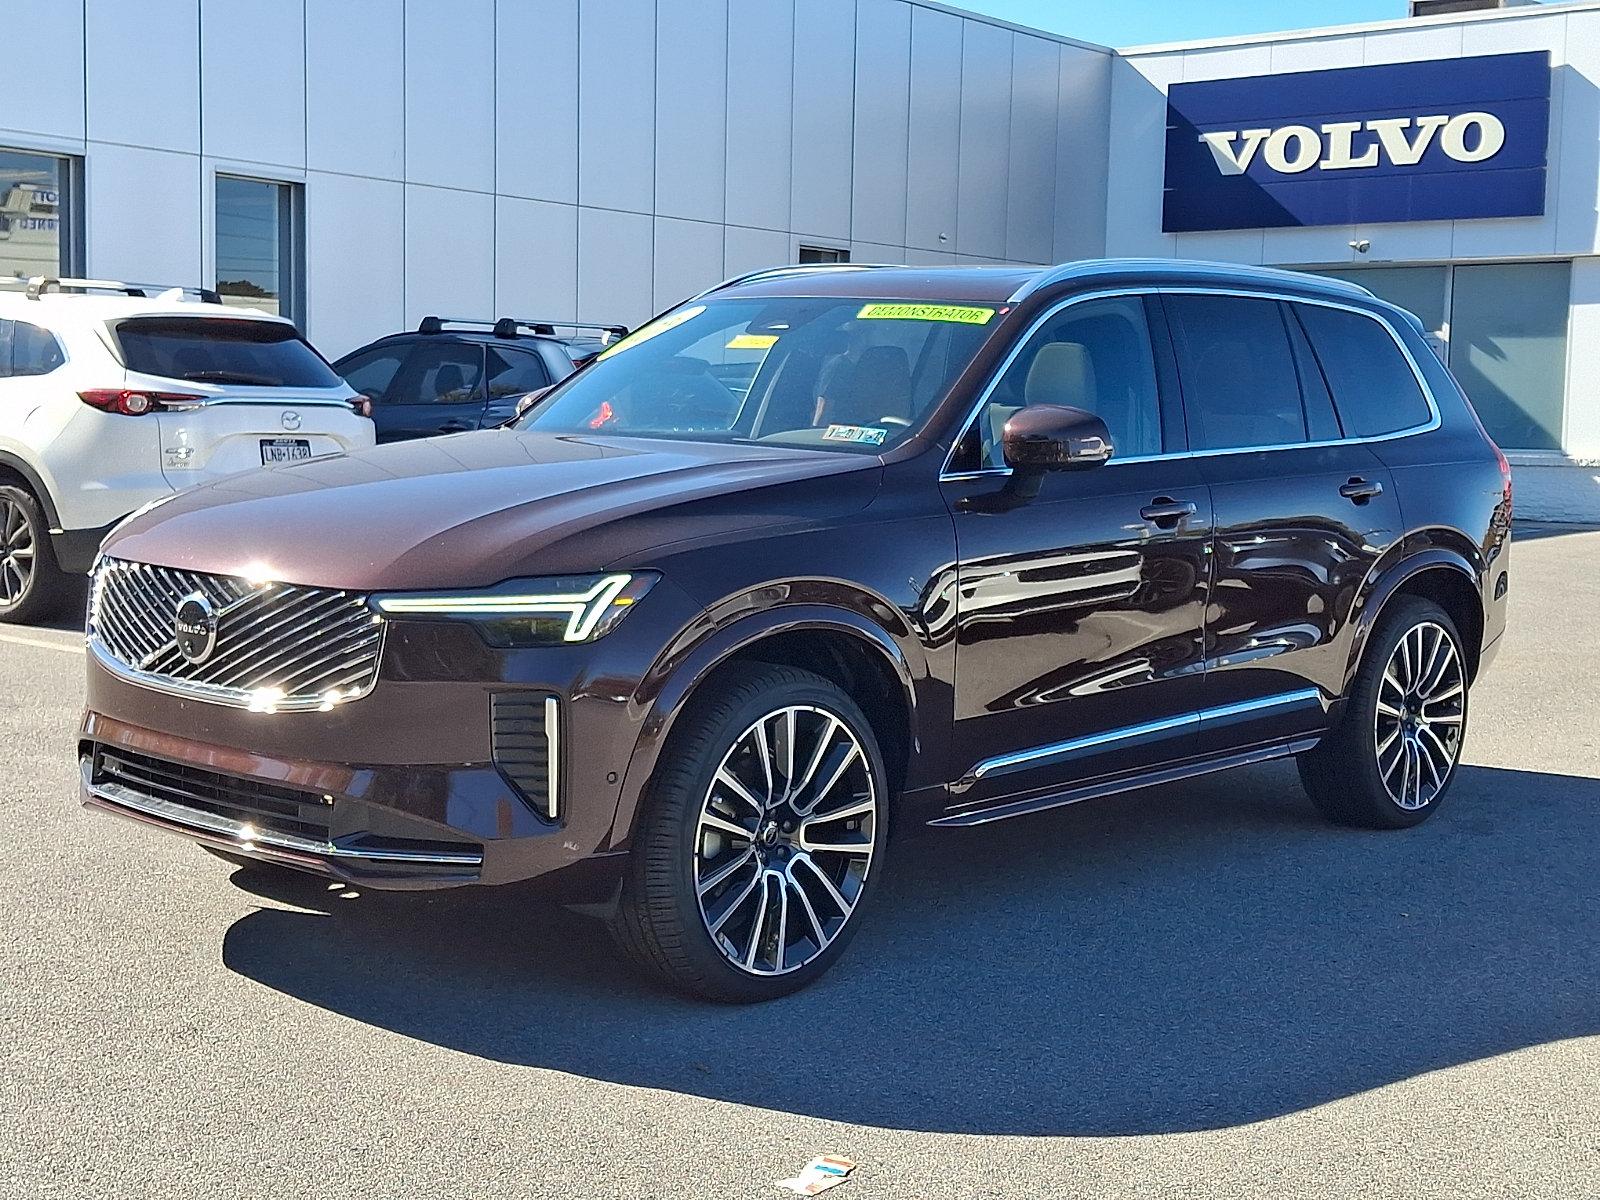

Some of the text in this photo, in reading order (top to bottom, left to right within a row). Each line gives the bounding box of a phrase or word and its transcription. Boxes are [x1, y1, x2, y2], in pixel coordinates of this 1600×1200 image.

[1198, 111, 1505, 176] VOLVO
[867, 306, 984, 321] DEMONSTRATOR
[178, 623, 207, 636] VOLVO
